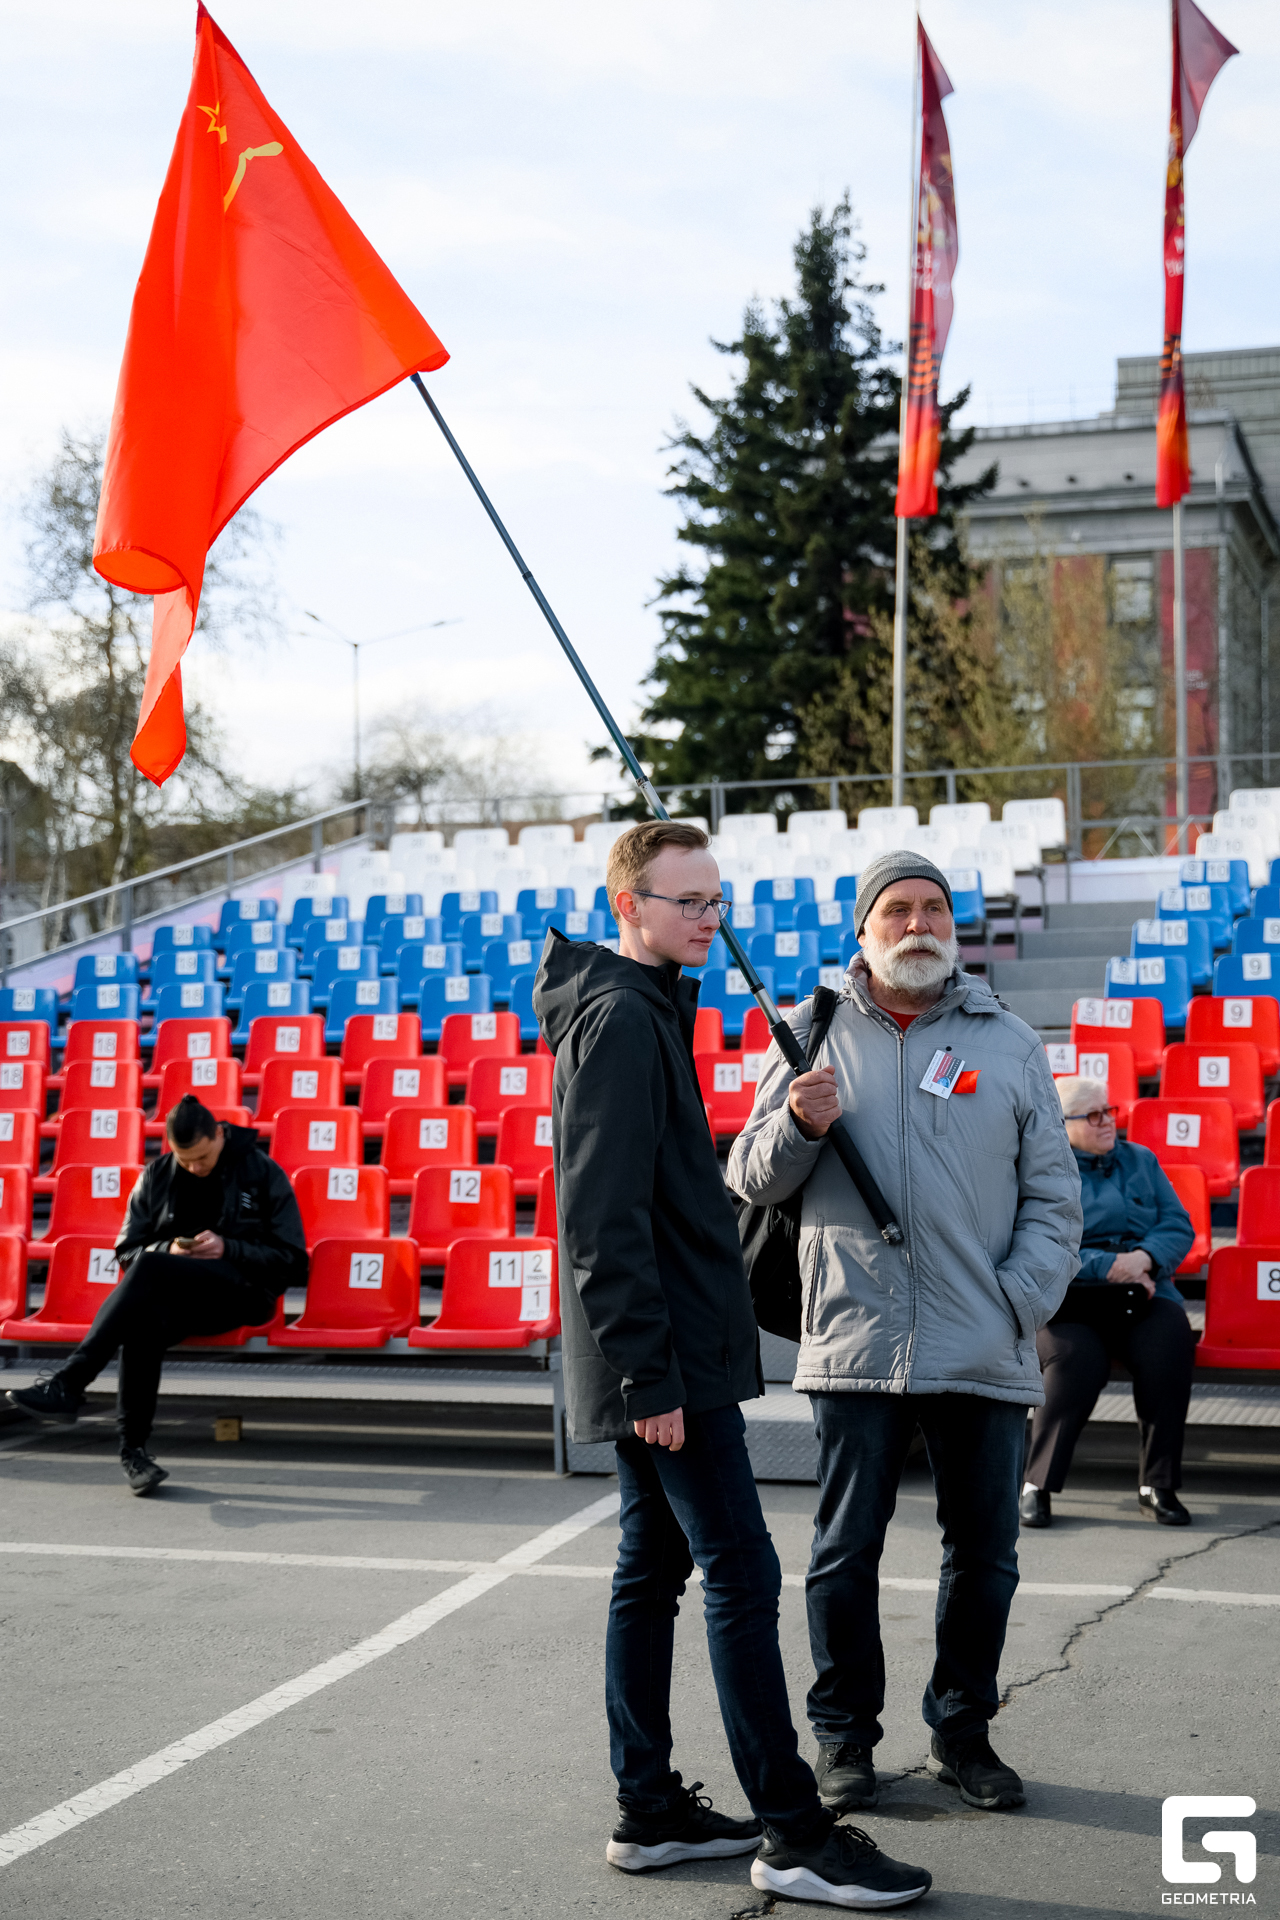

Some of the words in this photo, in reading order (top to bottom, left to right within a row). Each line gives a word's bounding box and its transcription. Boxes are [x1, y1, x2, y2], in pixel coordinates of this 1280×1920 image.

[1209, 862, 1226, 879] 10
[1190, 890, 1207, 909] 10
[1166, 923, 1186, 941] 10
[1142, 961, 1162, 980] 10
[1249, 957, 1262, 977] 9
[17, 992, 35, 1007] 20
[101, 988, 118, 1003] 19
[183, 988, 202, 1004] 18
[271, 987, 289, 1003] 17
[360, 985, 379, 1000] 16
[449, 983, 468, 998] 15
[1085, 1001, 1096, 1016] 5
[1108, 1004, 1131, 1024] 10
[1230, 1003, 1243, 1023] 9
[377, 1018, 396, 1036] 15
[475, 1017, 495, 1035] 14
[11, 1035, 29, 1052] 19
[98, 1038, 116, 1054] 18
[190, 1036, 209, 1053] 17
[280, 1031, 299, 1048] 16
[1055, 1047, 1066, 1061] 4
[3, 1068, 22, 1086] 18
[96, 1066, 116, 1084] 17
[195, 1063, 216, 1082] 16
[718, 1068, 737, 1087] 11
[1083, 1057, 1107, 1079] 10
[1206, 1061, 1220, 1082] 9
[294, 1073, 317, 1093] 15
[396, 1073, 417, 1092] 14
[503, 1070, 526, 1090] 13
[96, 1113, 117, 1134] 16
[536, 1121, 552, 1141] 1
[1176, 1119, 1190, 1141] 9
[313, 1126, 336, 1147] 14
[423, 1123, 446, 1145] 13
[96, 1173, 119, 1194] 15
[332, 1174, 356, 1195] 13
[453, 1176, 479, 1197] 12
[93, 1255, 118, 1277] 14
[353, 1259, 382, 1283] 12
[493, 1258, 515, 1280] 11
[532, 1254, 543, 1273] 2
[1268, 1268, 1280, 1293] 8
[534, 1289, 540, 1308] 1
